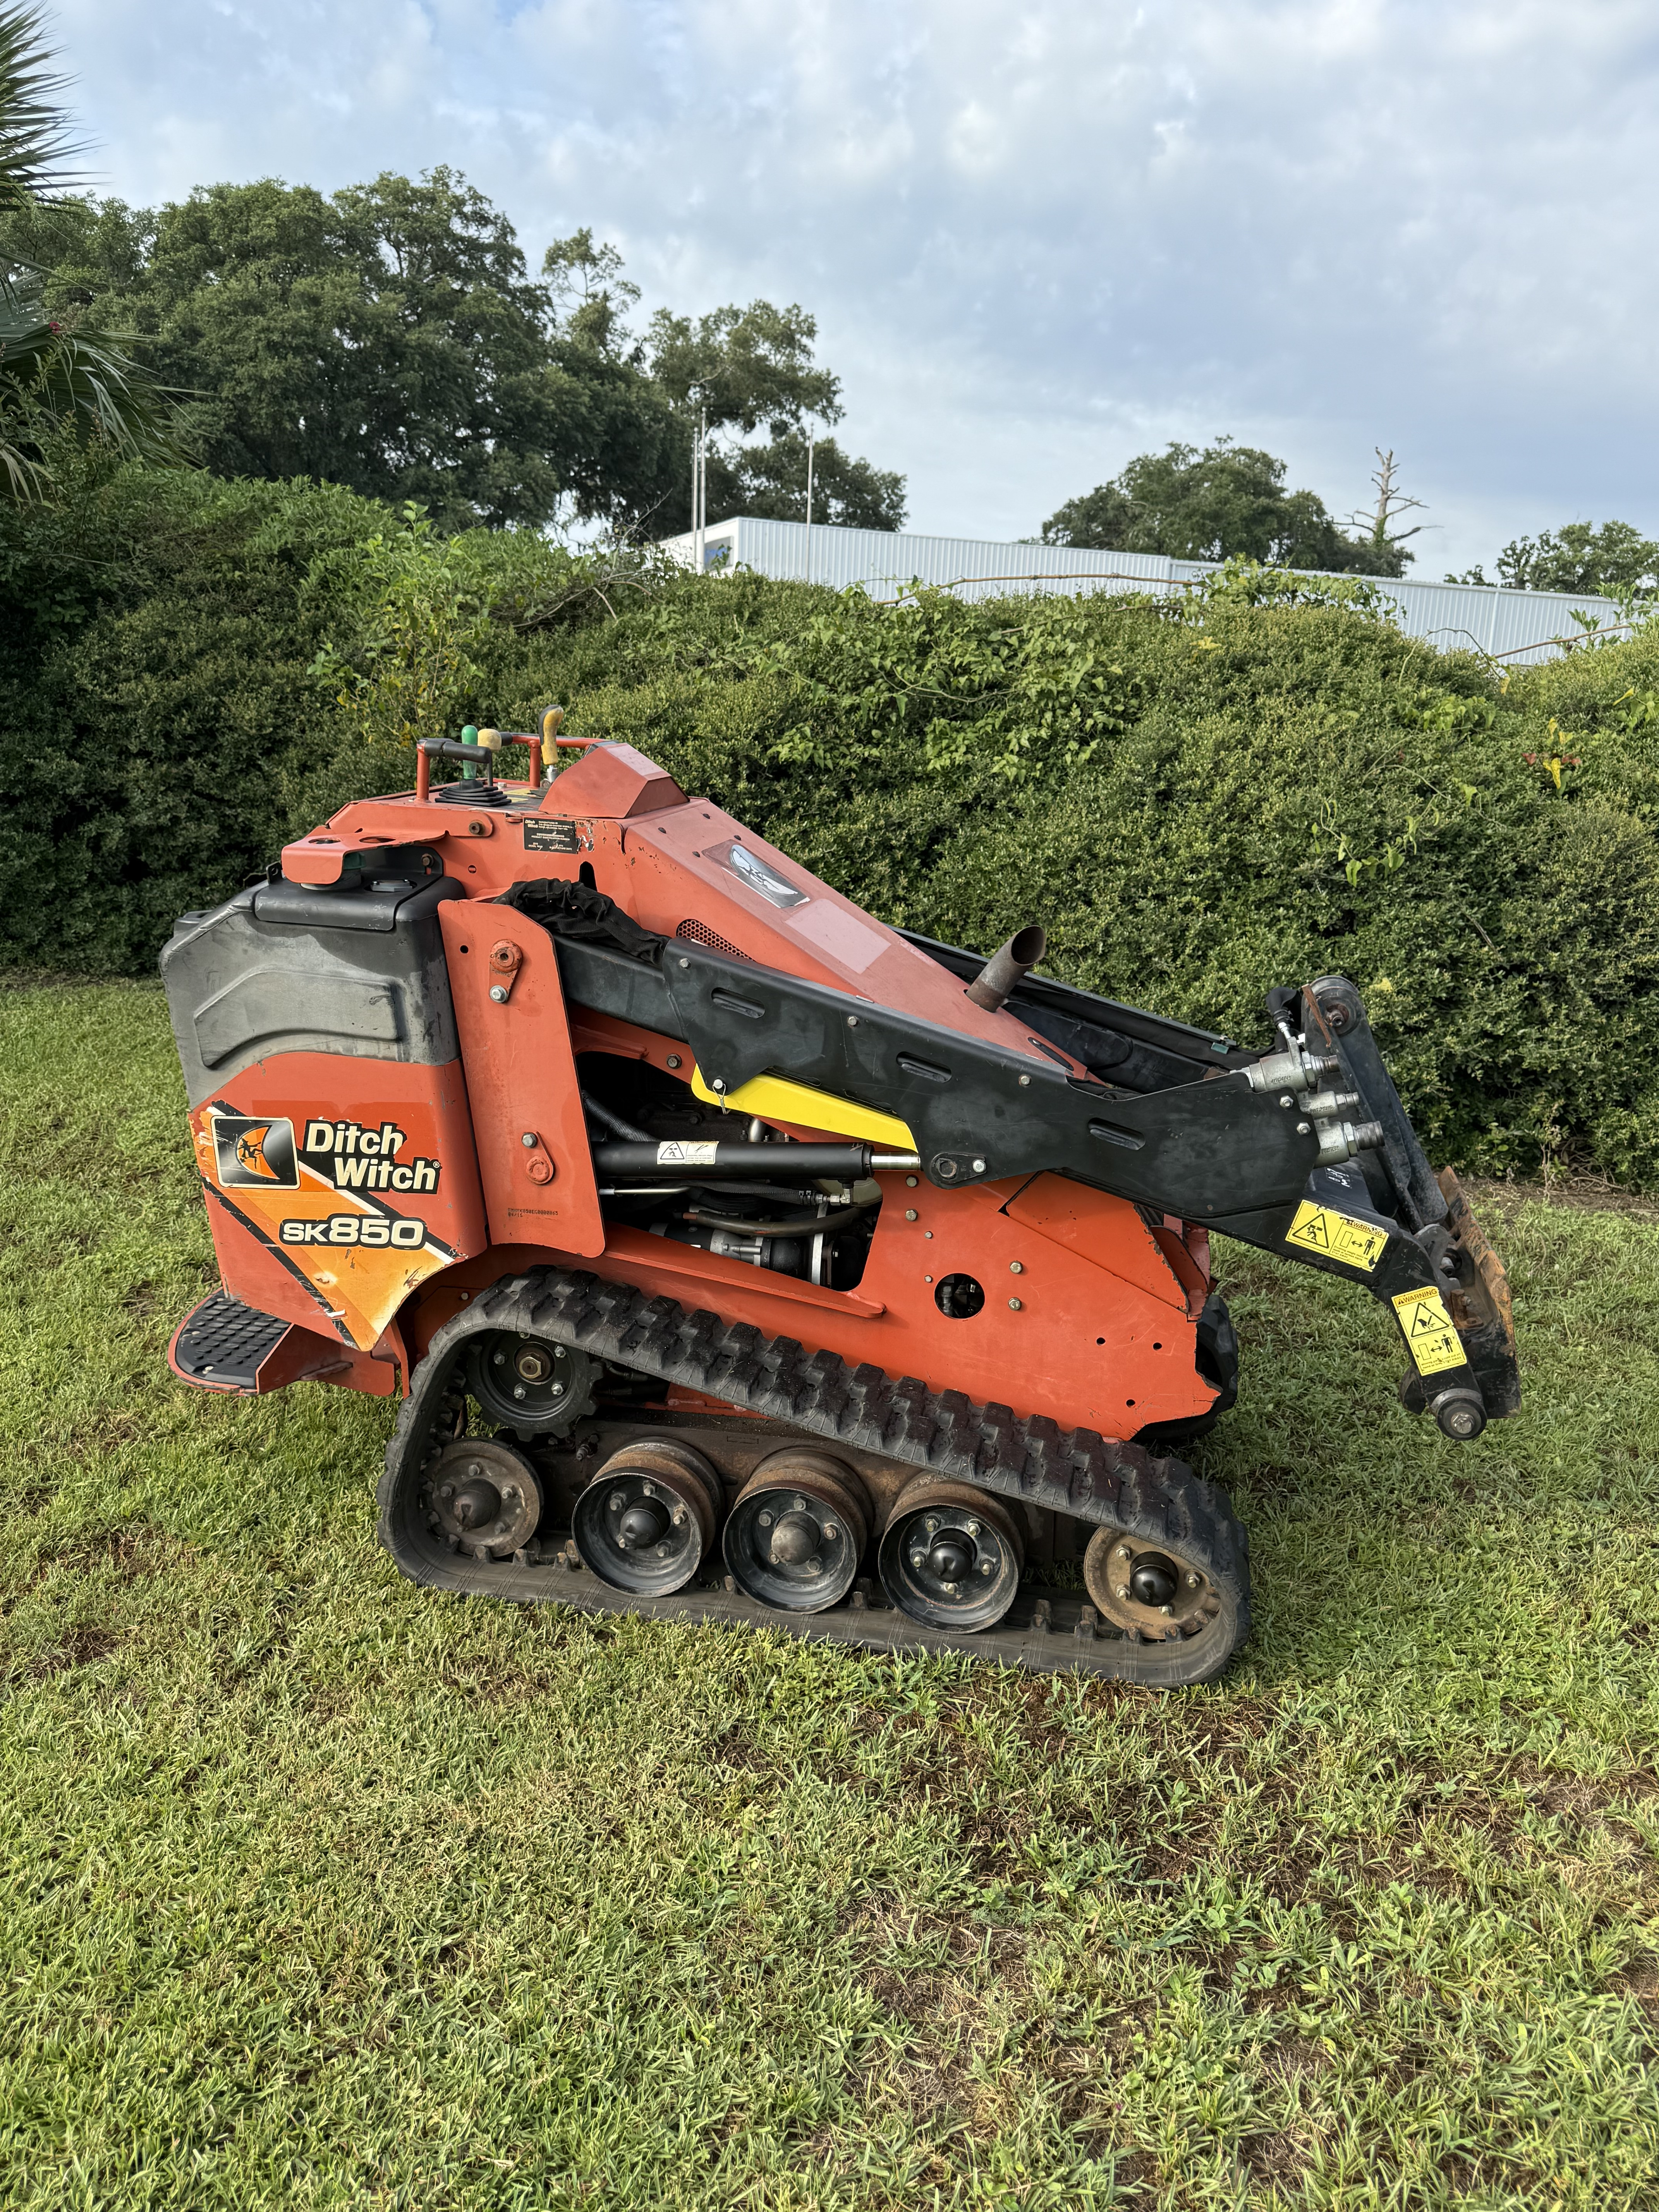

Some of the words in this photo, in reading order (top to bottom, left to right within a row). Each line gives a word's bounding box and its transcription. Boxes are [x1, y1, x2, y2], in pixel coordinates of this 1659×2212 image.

[306, 1122, 404, 1155] Ditch
[335, 1158, 434, 1190] Witch
[283, 1217, 424, 1246] SK850
[1353, 1221, 1382, 1236] WARNING
[1403, 1289, 1437, 1302] WARNING
